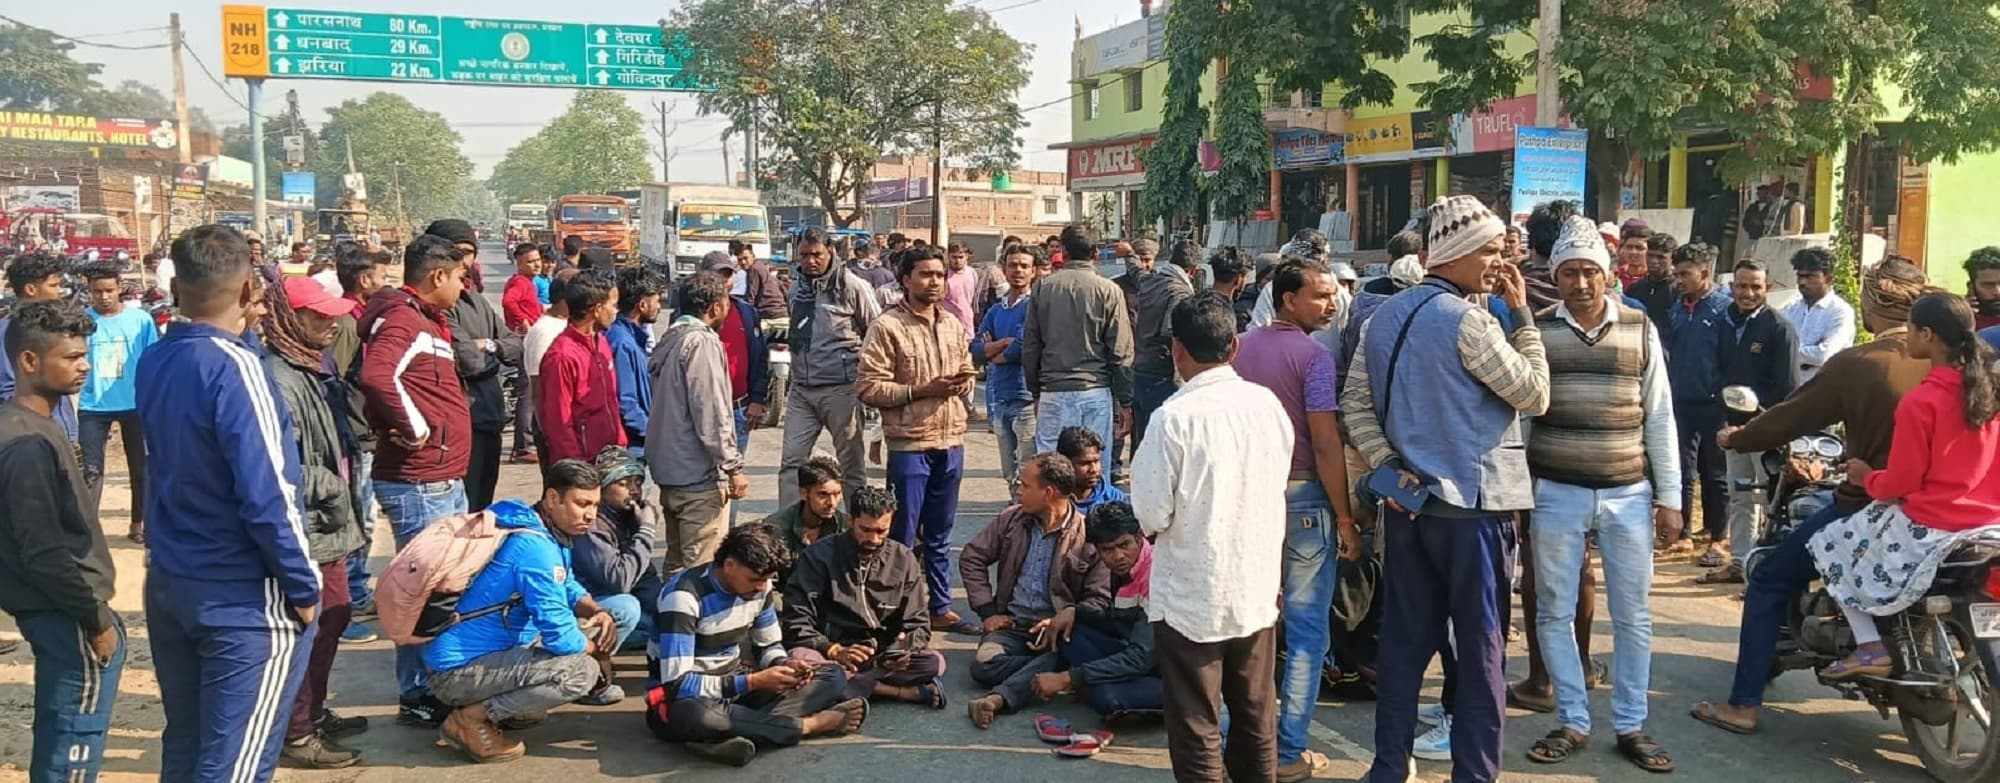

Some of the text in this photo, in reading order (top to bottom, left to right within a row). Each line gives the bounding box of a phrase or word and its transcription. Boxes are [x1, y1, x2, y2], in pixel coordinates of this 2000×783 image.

[296, 13, 362, 28] पारसनाथ
[231, 23, 256, 36] NH
[615, 27, 652, 44] देवघर
[231, 43, 260, 55] 218
[296, 36, 351, 52] धनबाद
[390, 39, 405, 54] 29
[297, 56, 346, 73] झरिया
[391, 62, 406, 77] 22
[16, 112, 52, 126] MAA
[56, 115, 97, 129] TARA
[110, 132, 149, 146] HOTEL
